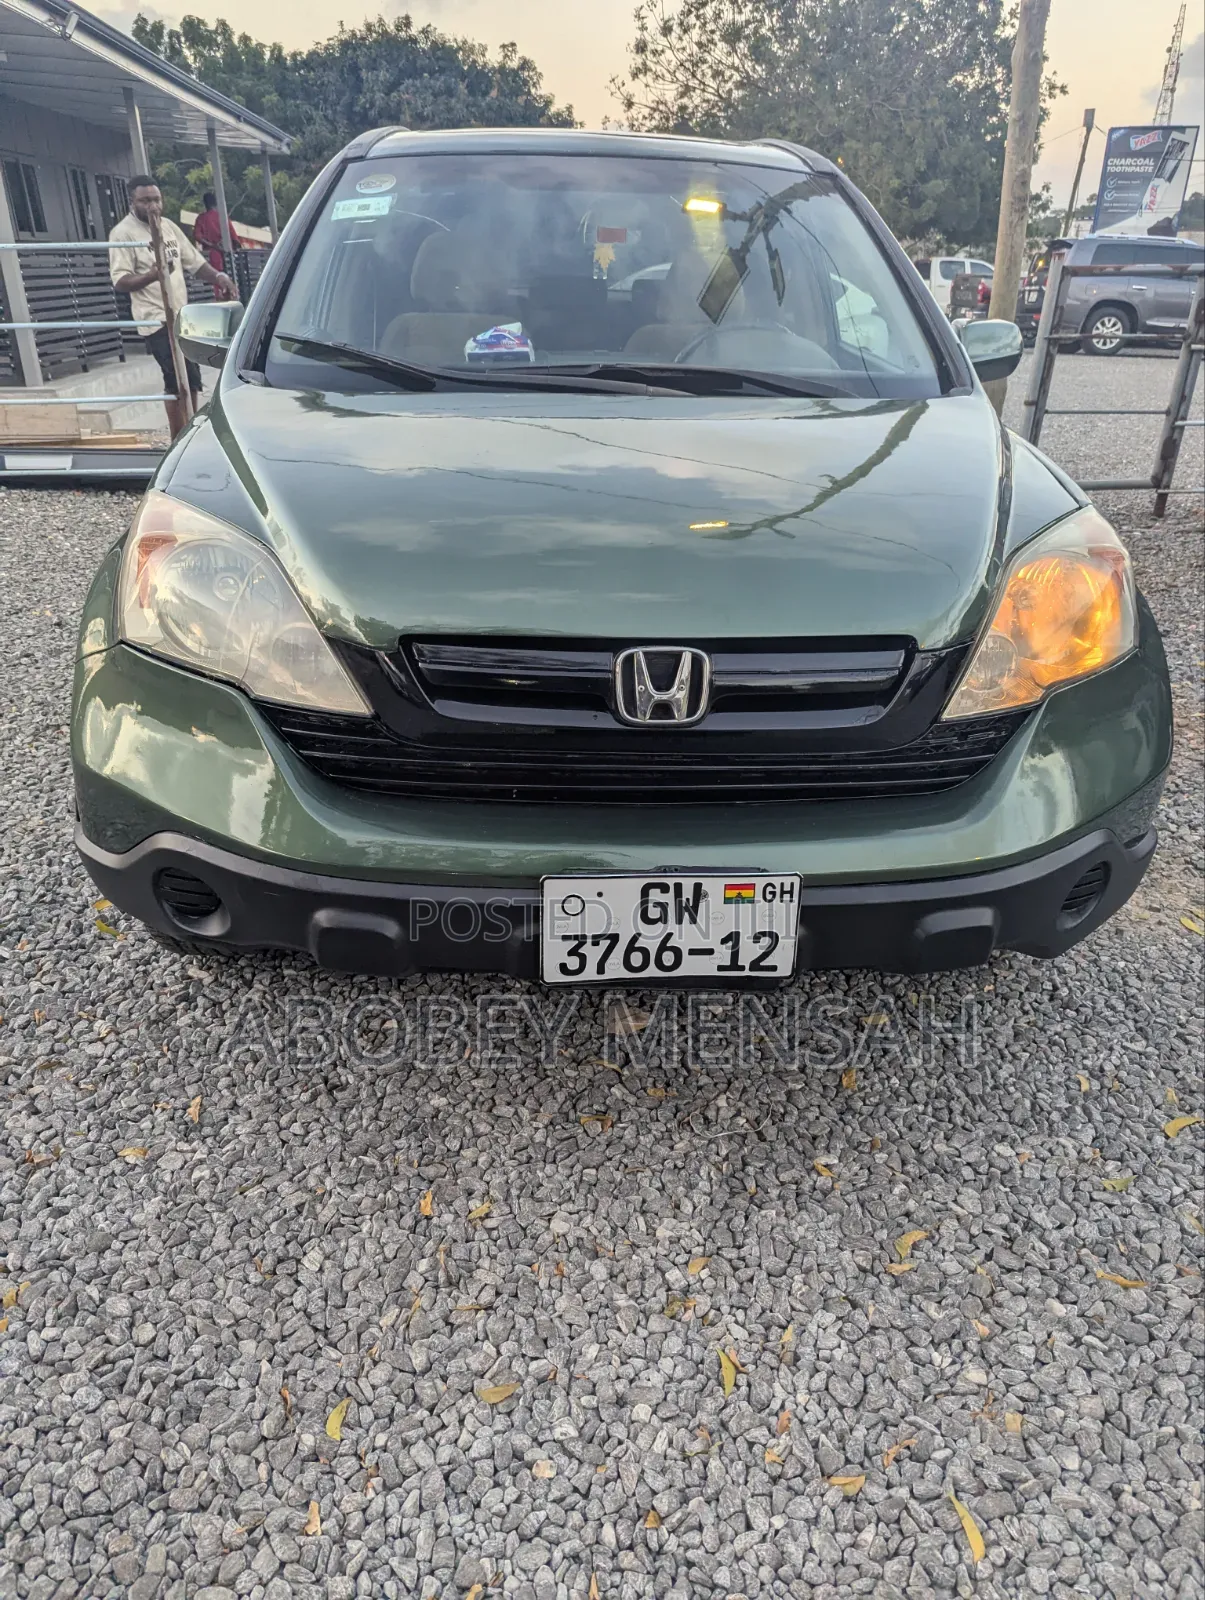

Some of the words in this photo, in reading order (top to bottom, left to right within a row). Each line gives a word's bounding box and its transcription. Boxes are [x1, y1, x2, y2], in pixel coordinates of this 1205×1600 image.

[1106, 165, 1154, 173] TOOTHPASTE
[1107, 157, 1155, 166] CHARCOAL
[640, 881, 703, 926] GW
[761, 881, 795, 904] GH
[558, 930, 780, 977] 3766-12
